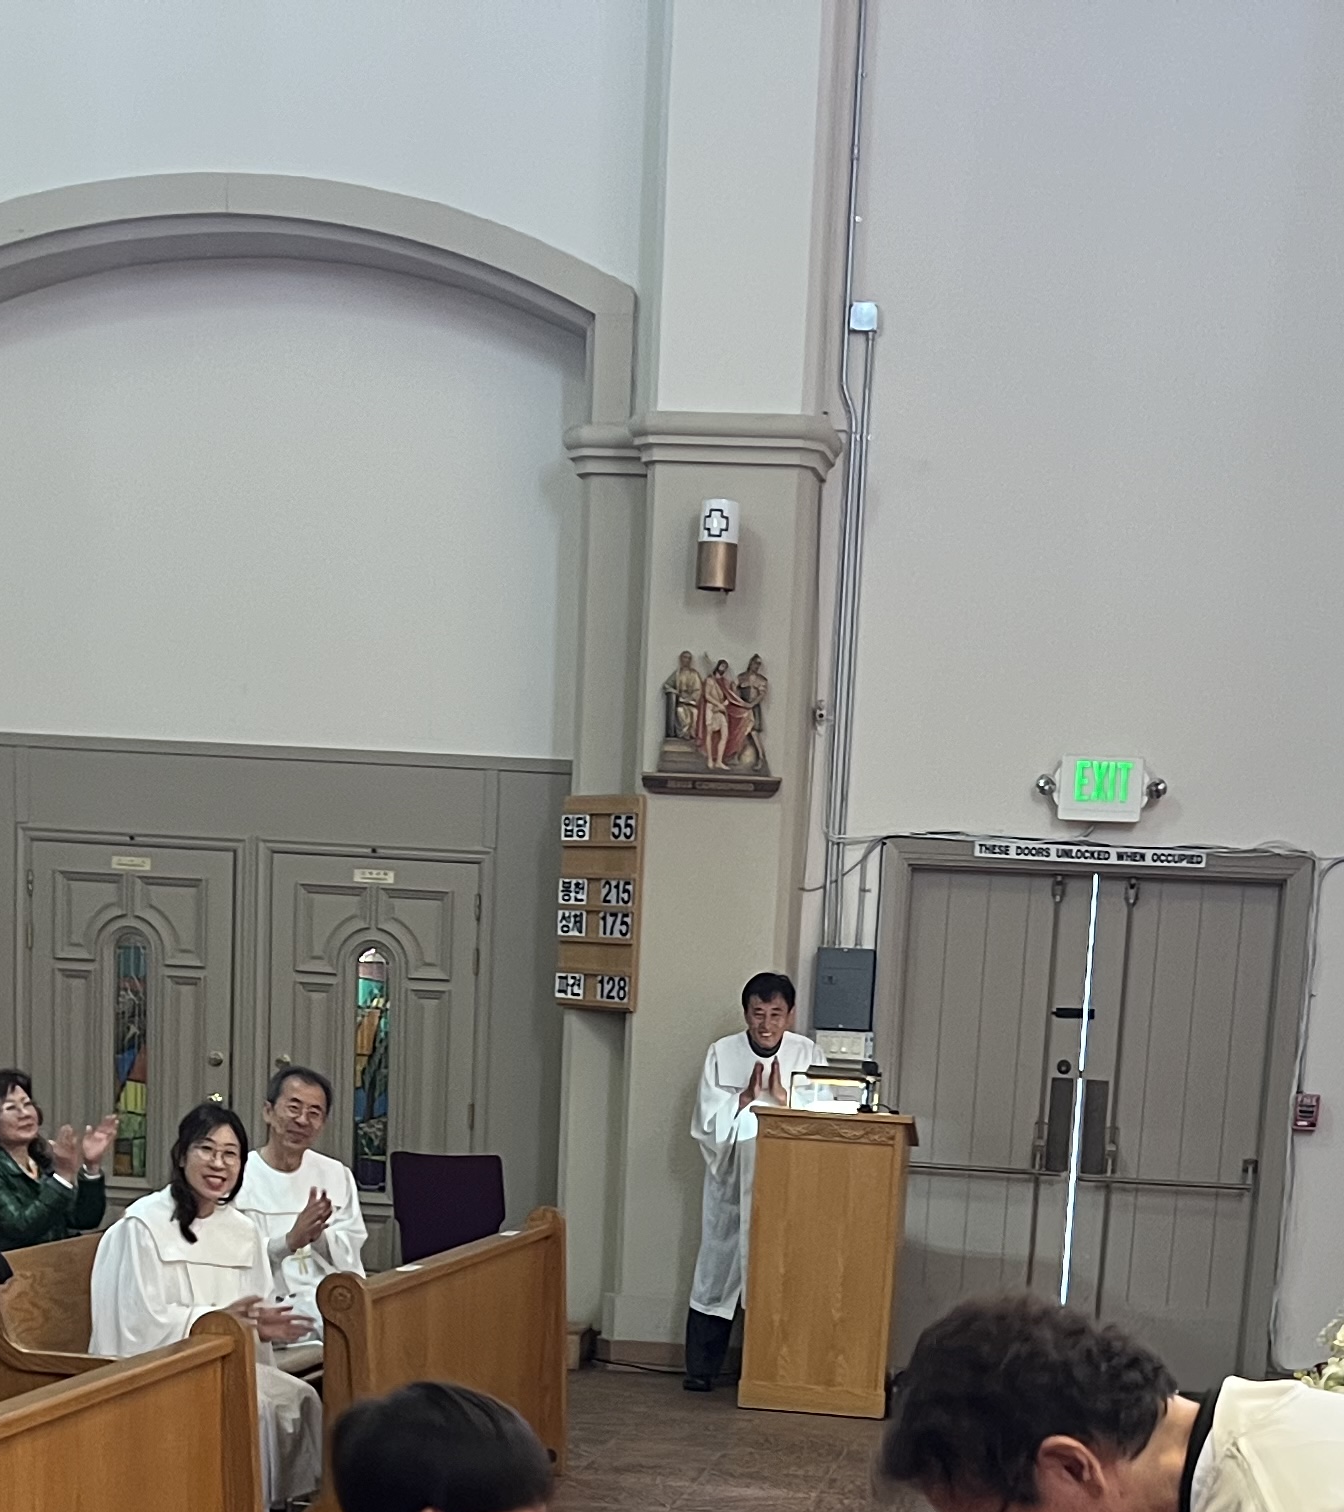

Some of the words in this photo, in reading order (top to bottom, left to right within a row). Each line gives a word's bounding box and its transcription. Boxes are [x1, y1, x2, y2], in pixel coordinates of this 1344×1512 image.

[1074, 760, 1134, 802] EXIT
[563, 816, 588, 838] 입당
[611, 815, 634, 840] 55
[978, 843, 1011, 856] THESE
[1015, 845, 1051, 858] DOORS
[1055, 847, 1111, 861] UNLOCKED
[1116, 851, 1146, 862] WHEN
[1151, 852, 1203, 865] OCCUPIED
[560, 880, 585, 903] 봉헌
[601, 880, 632, 905] 215
[559, 911, 584, 934] 성체
[601, 911, 630, 937] 175
[557, 974, 582, 997] 파견
[598, 975, 627, 1001] 128
